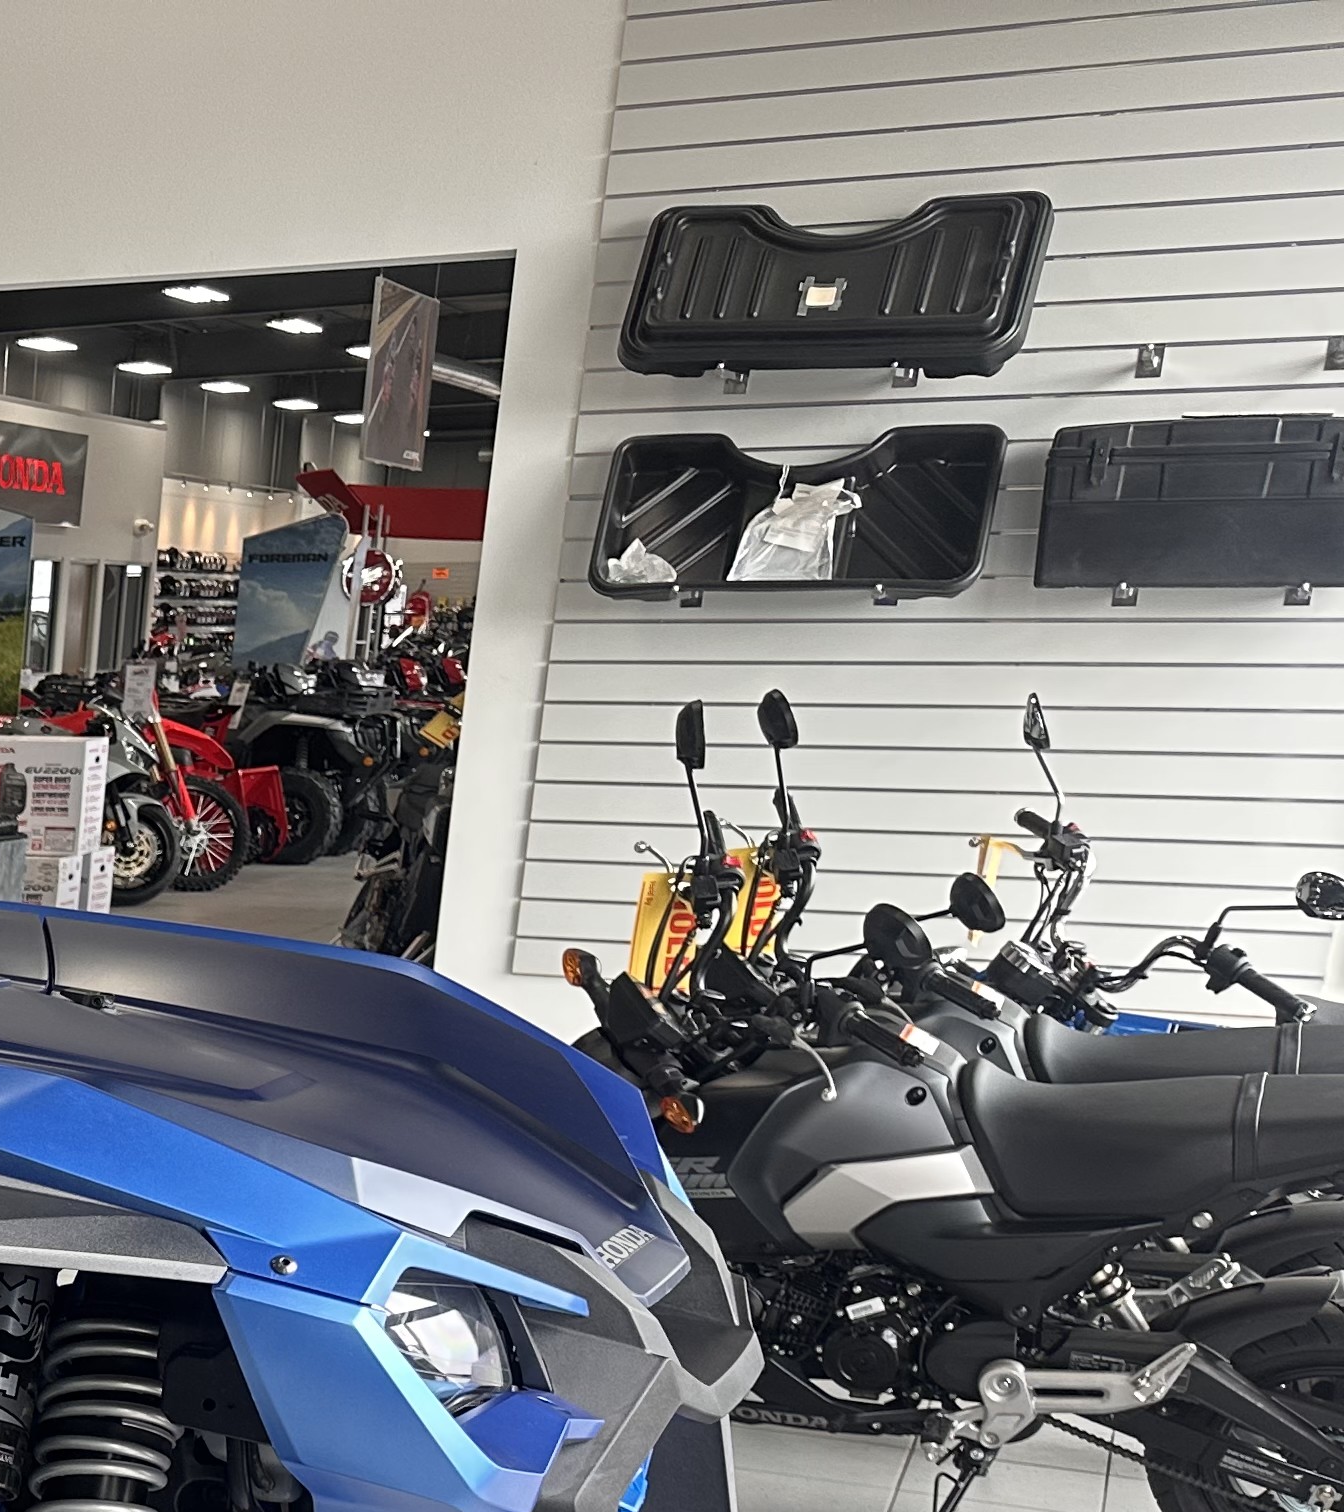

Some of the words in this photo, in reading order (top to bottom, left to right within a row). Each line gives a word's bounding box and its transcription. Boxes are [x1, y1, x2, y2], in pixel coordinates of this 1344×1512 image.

[248, 552, 329, 564] FOREMAN
[595, 1224, 657, 1269] HONDA
[732, 1406, 829, 1430] ONDA
